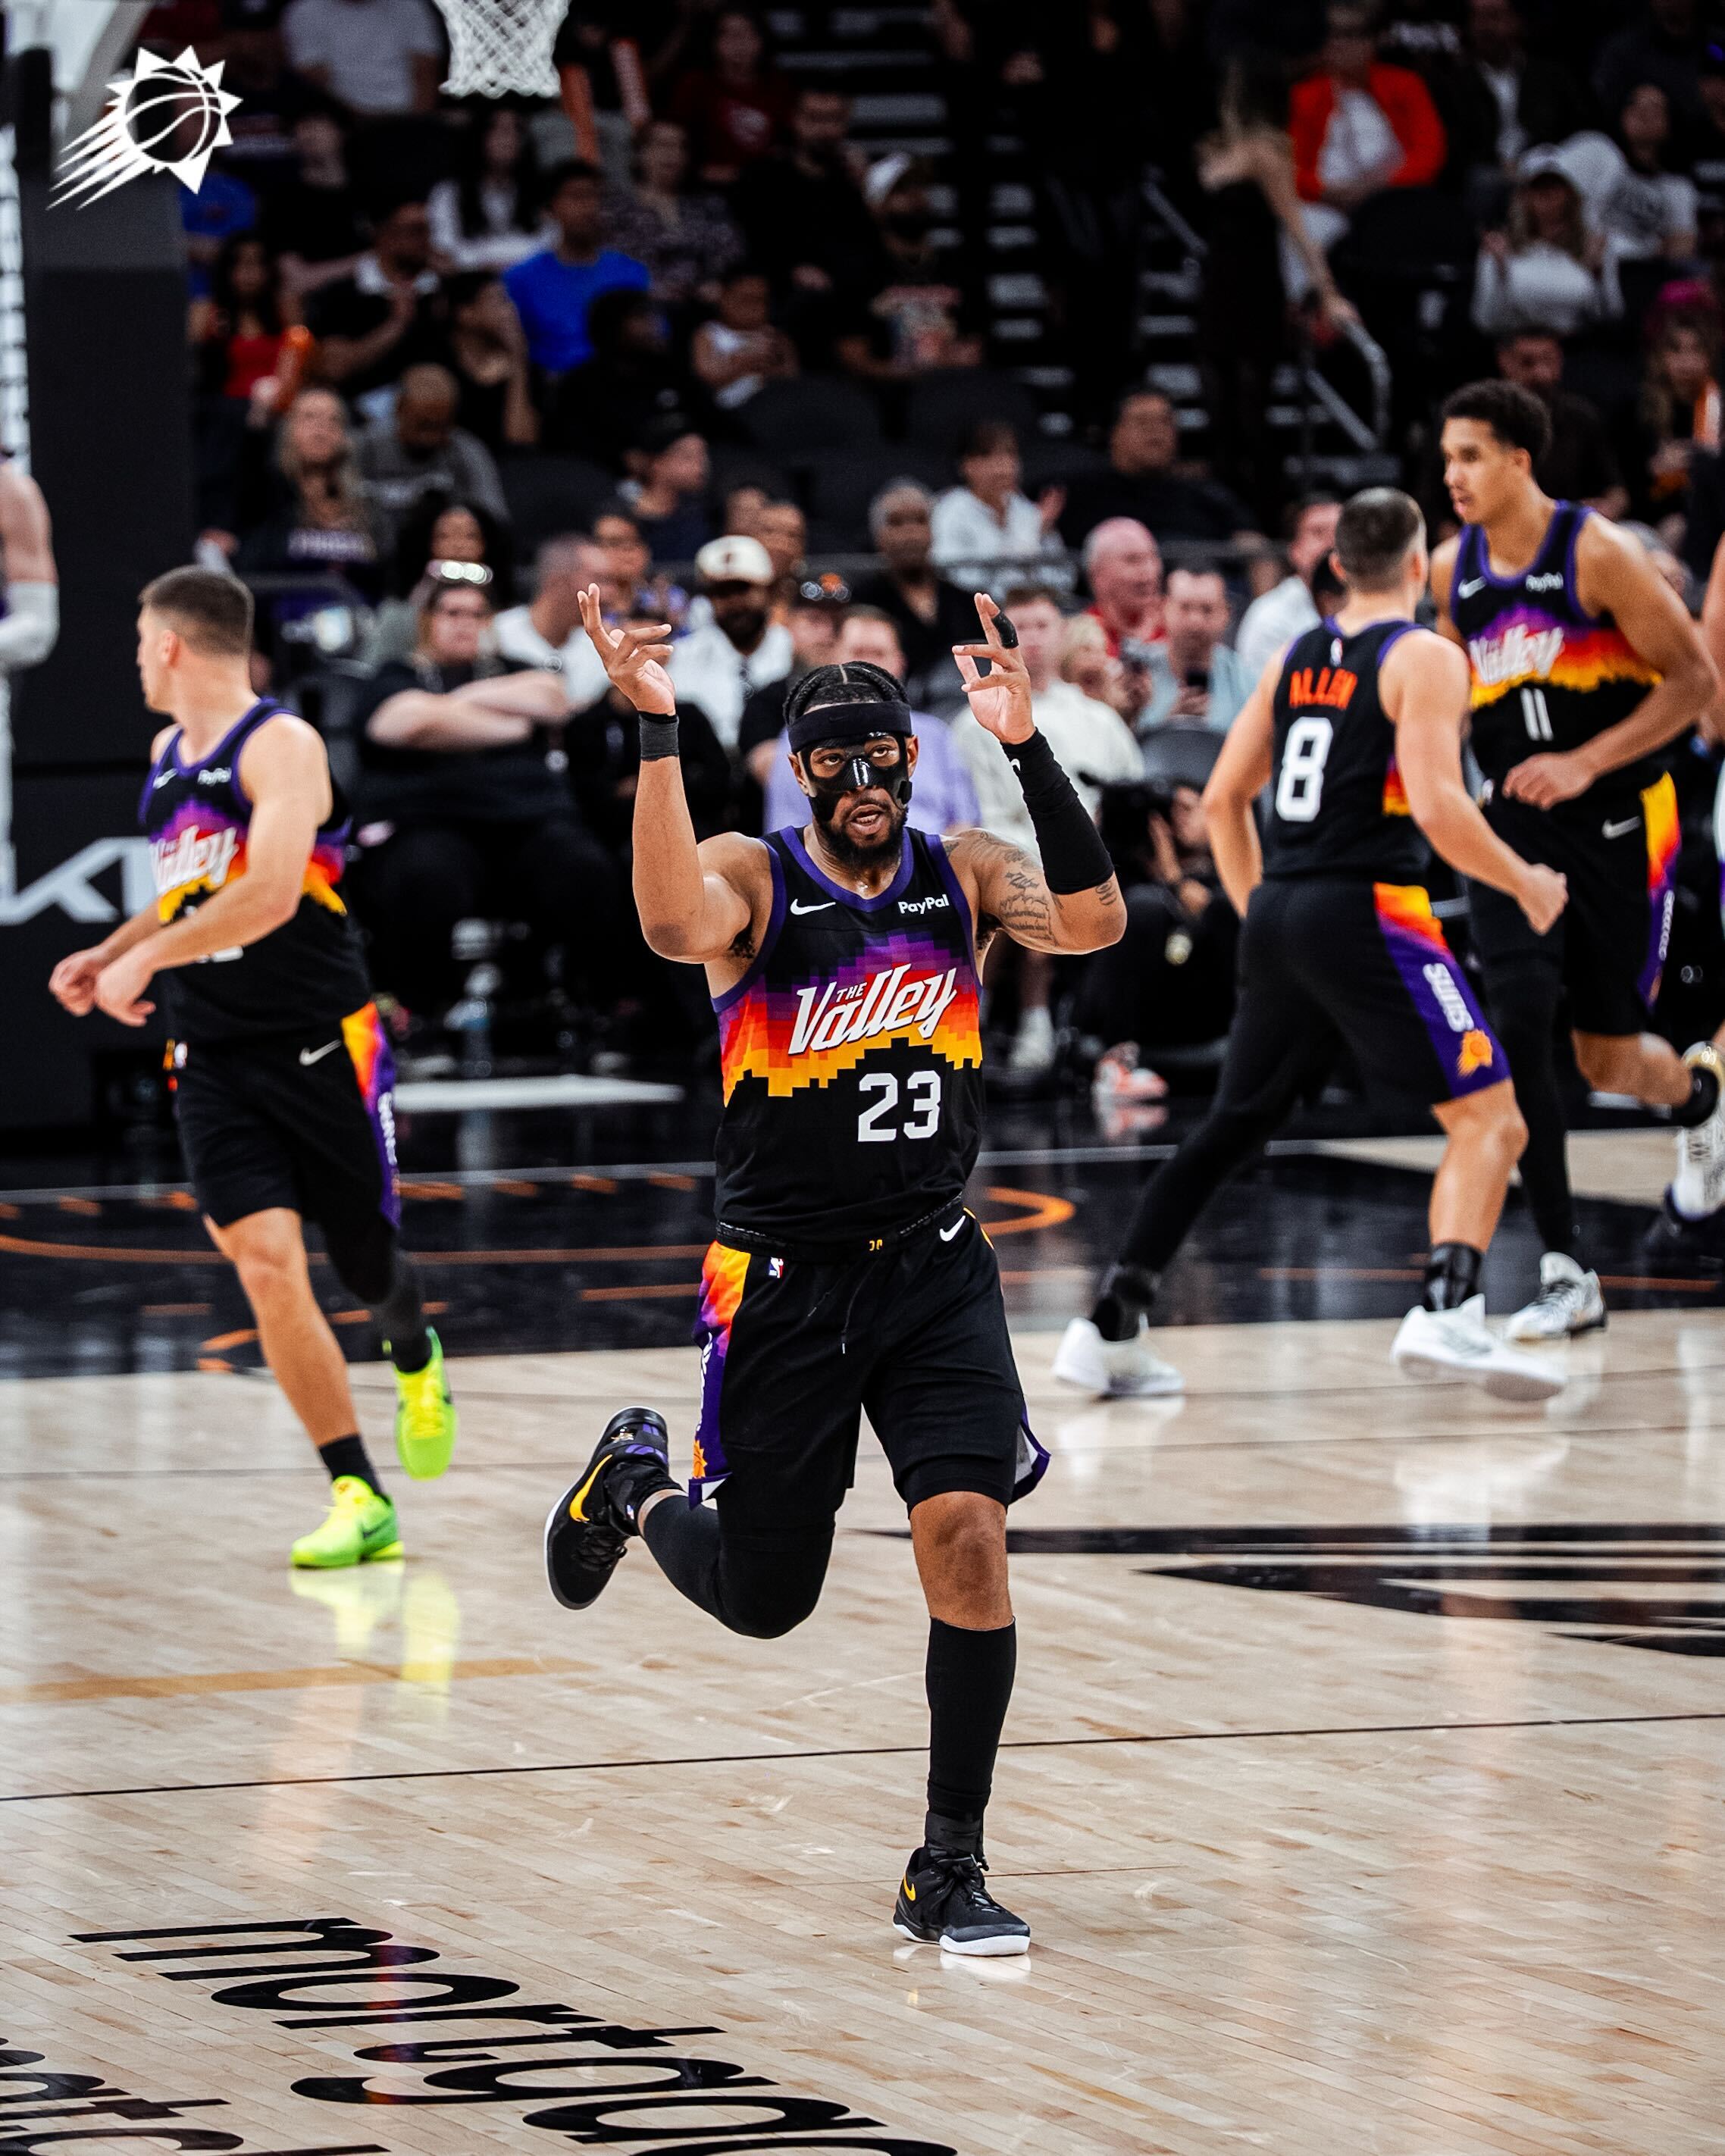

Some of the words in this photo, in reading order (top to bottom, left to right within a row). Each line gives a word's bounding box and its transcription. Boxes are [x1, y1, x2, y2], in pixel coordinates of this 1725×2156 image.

[1520, 688, 1554, 741] 11
[1276, 716, 1333, 822] 8
[898, 894, 949, 915] PayPal
[787, 964, 957, 1056] Valley
[836, 982, 867, 1003] THE
[858, 1070, 941, 1142] 23
[68, 1917, 956, 2156] mortga
